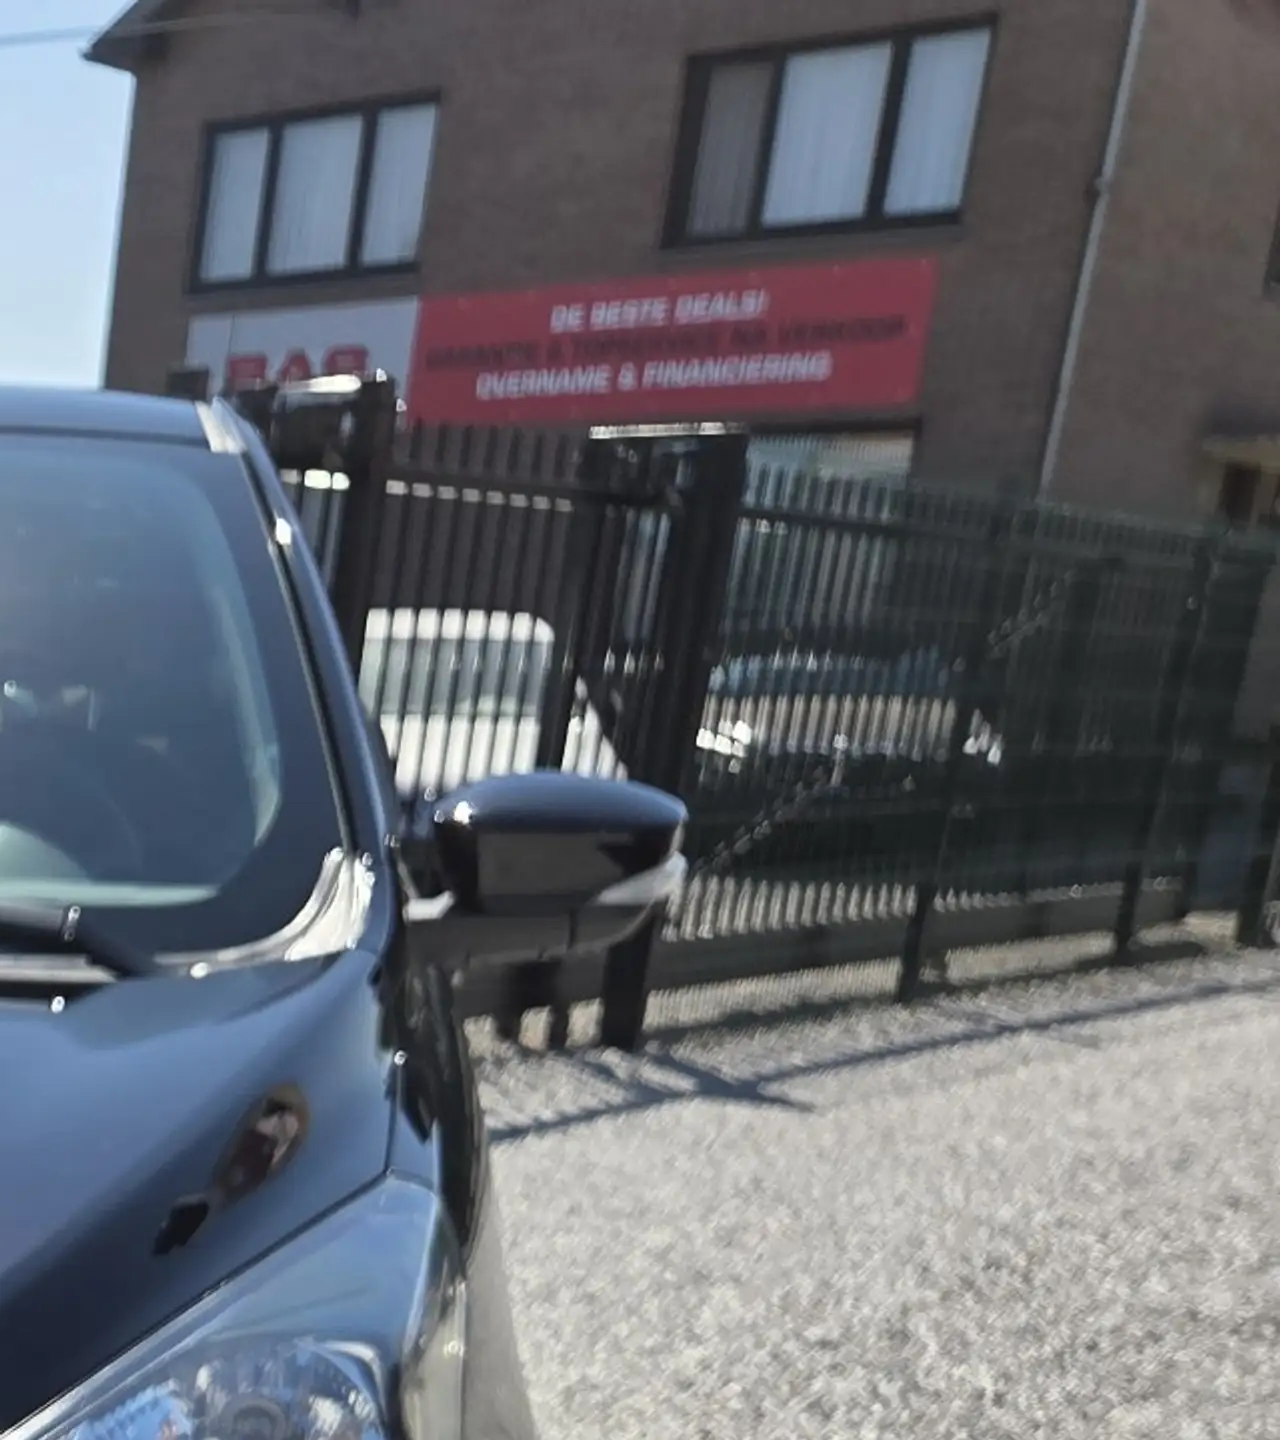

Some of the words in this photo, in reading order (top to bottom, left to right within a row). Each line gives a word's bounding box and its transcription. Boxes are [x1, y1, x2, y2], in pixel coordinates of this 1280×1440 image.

[550, 303, 586, 333] DE
[590, 296, 670, 331] BESTE
[674, 288, 770, 326] DEALS!
[476, 363, 614, 401] OVERNAME
[642, 350, 833, 389] FINANCIERING
